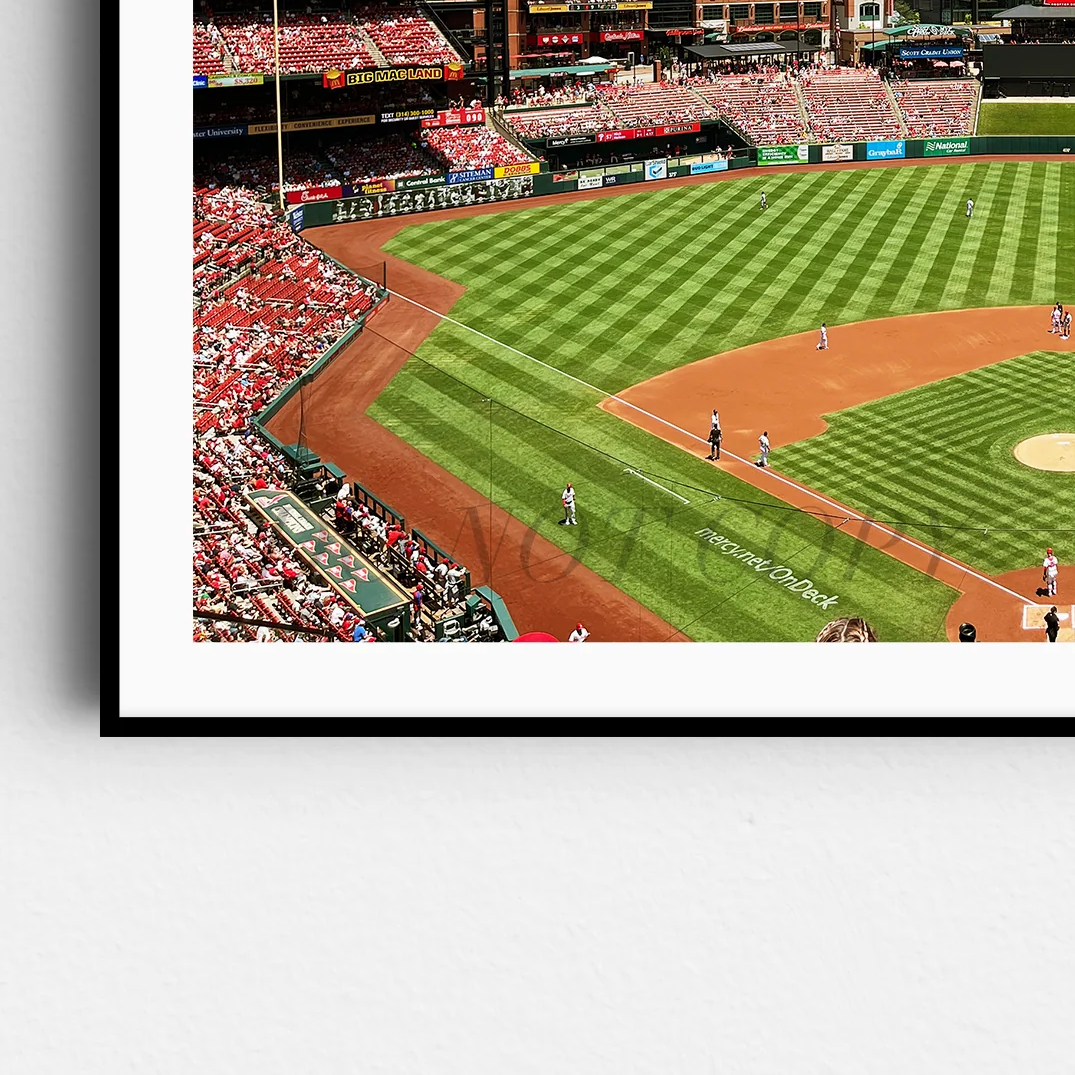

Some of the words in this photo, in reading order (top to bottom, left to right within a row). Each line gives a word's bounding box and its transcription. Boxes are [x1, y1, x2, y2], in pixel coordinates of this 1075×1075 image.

[901, 49, 919, 57] SCOTT
[347, 72, 374, 86] BIG
[375, 68, 408, 83] MAC
[408, 67, 443, 80] LAND
[395, 110, 410, 118] (314)
[410, 108, 435, 117] 300-1000
[294, 120, 332, 129] CONVENIENCE
[337, 116, 371, 125] EXPERIENCE
[207, 127, 244, 137] University
[669, 125, 693, 133] PURINA
[935, 141, 968, 150] National
[459, 169, 492, 179] SITEMAN
[503, 165, 531, 174] DOBBS
[406, 178, 428, 187] Central
[429, 176, 446, 184] Bank
[694, 525, 839, 612] mercy.net/OnDeck
